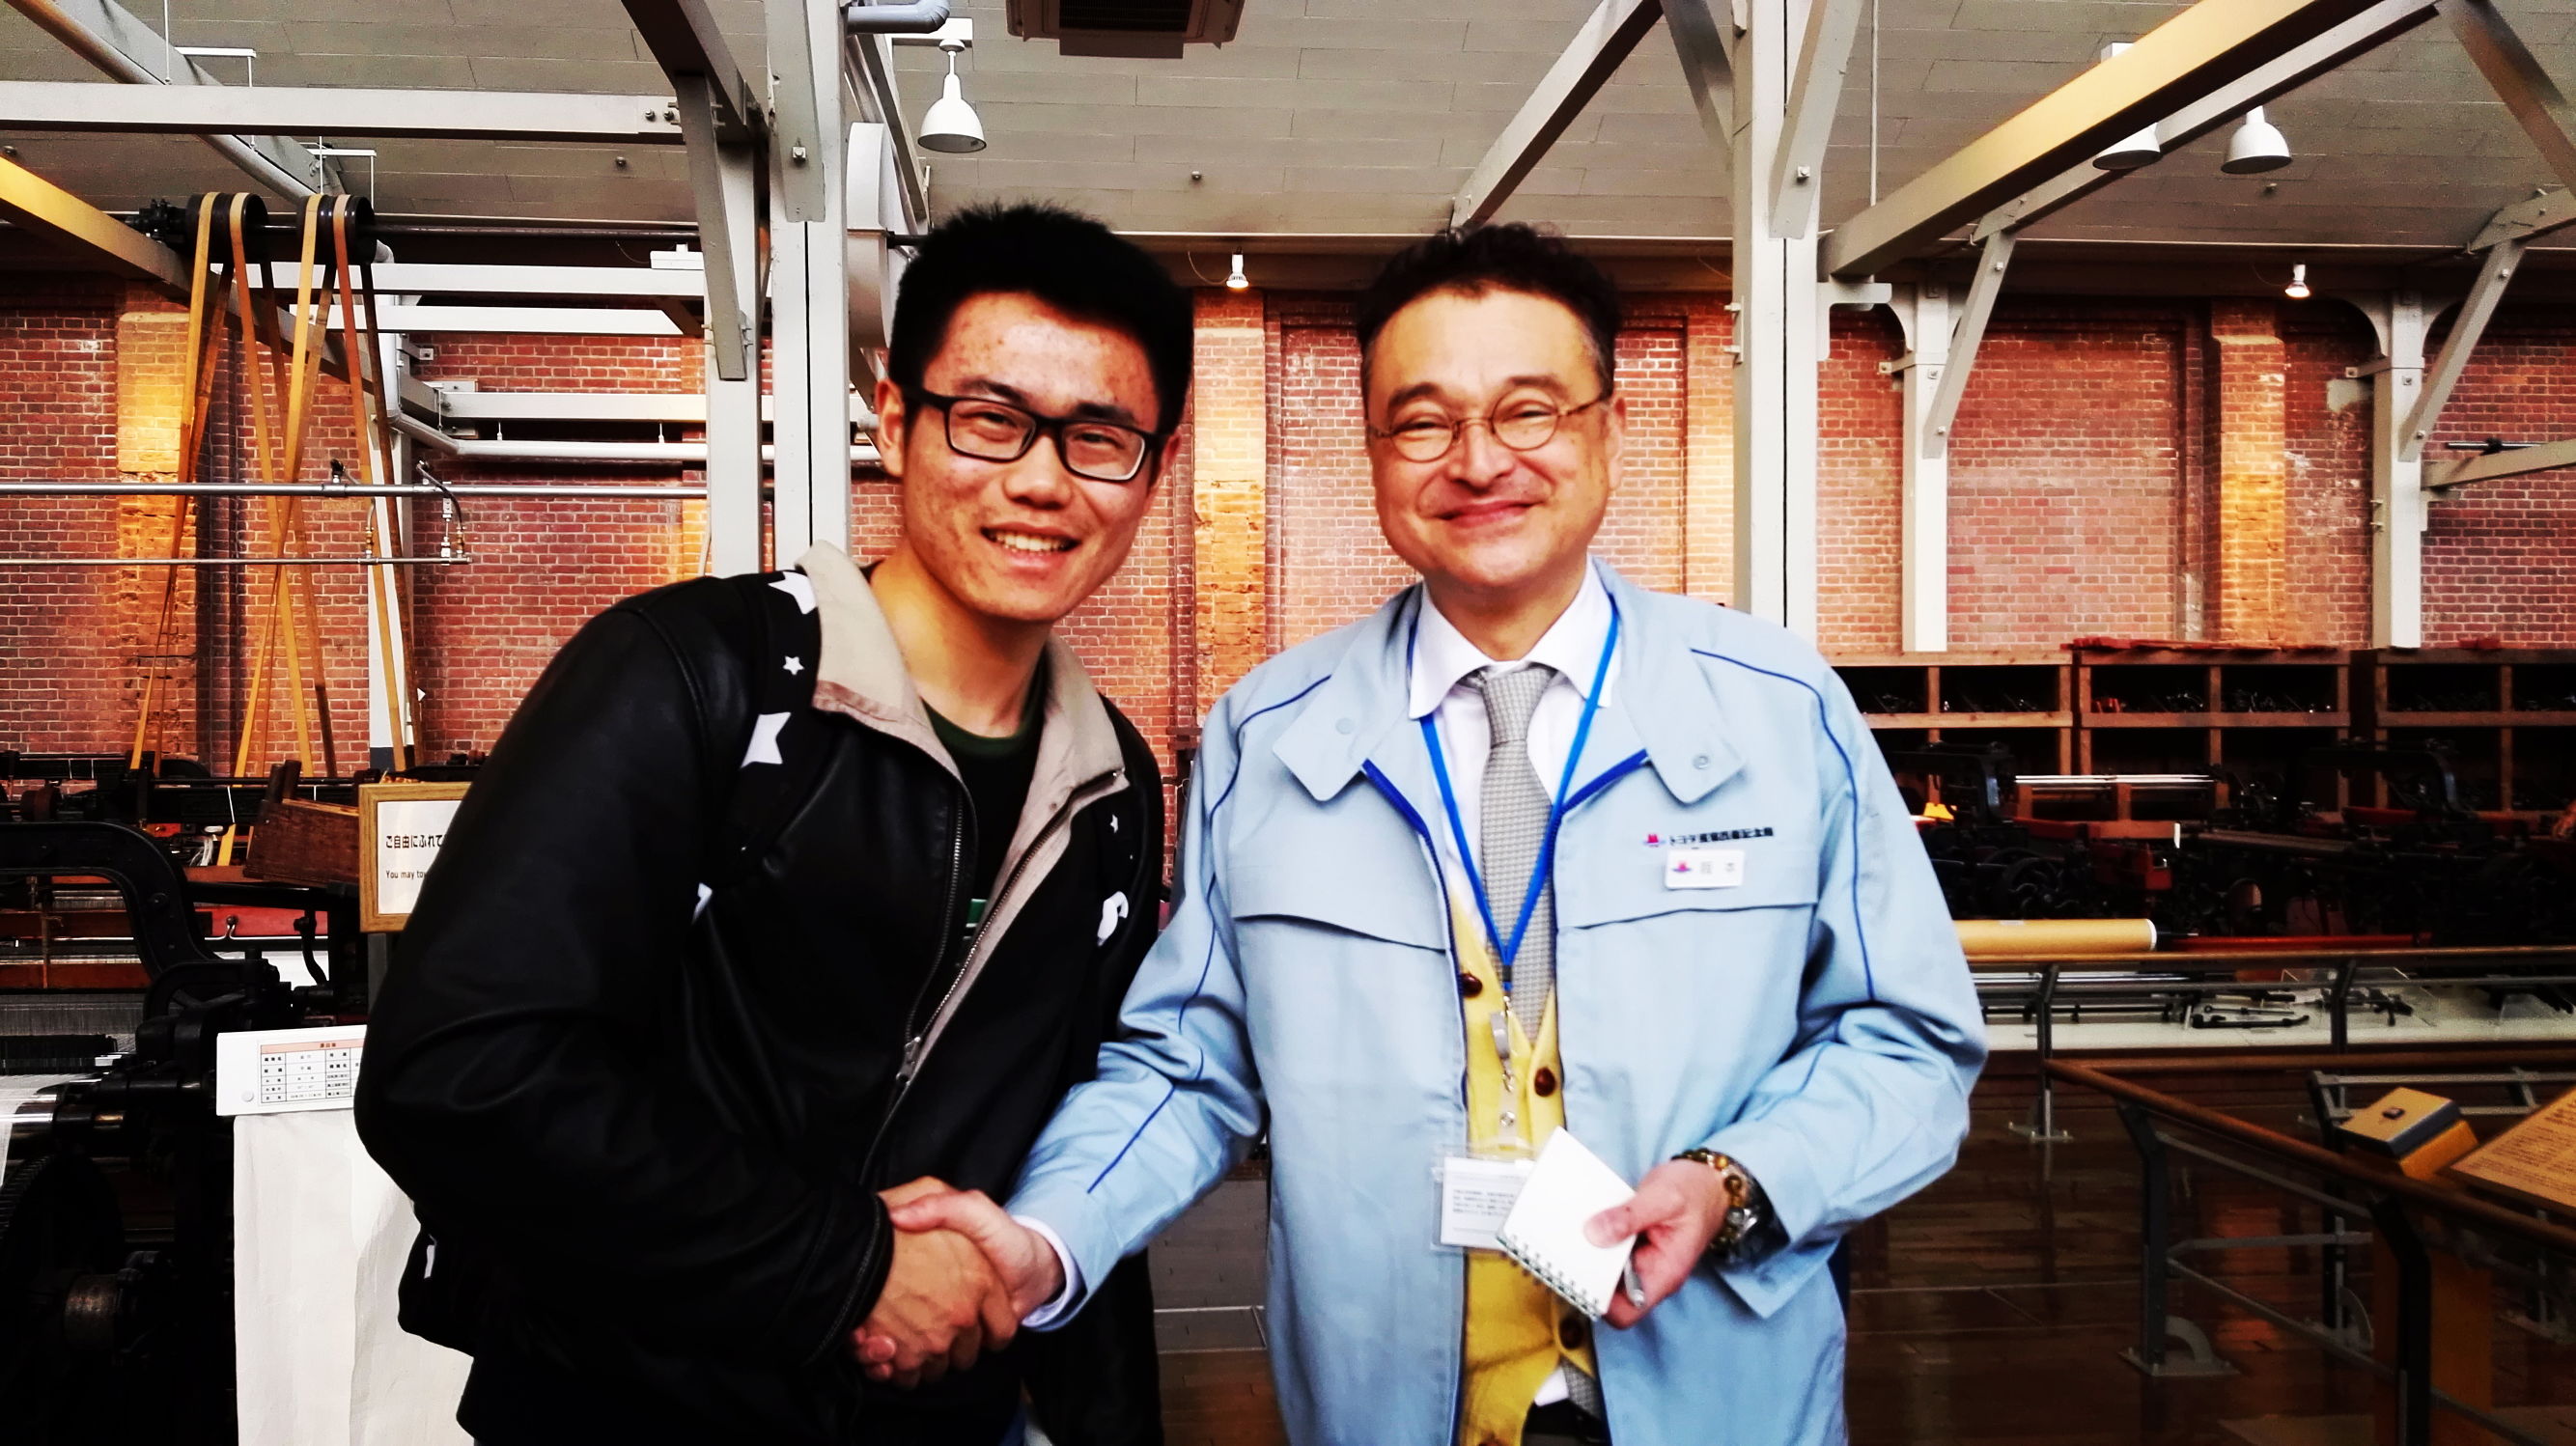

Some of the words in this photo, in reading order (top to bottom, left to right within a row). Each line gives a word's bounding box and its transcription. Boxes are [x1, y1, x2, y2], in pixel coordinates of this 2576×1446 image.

[386, 834, 443, 848] ご自由にふれて
